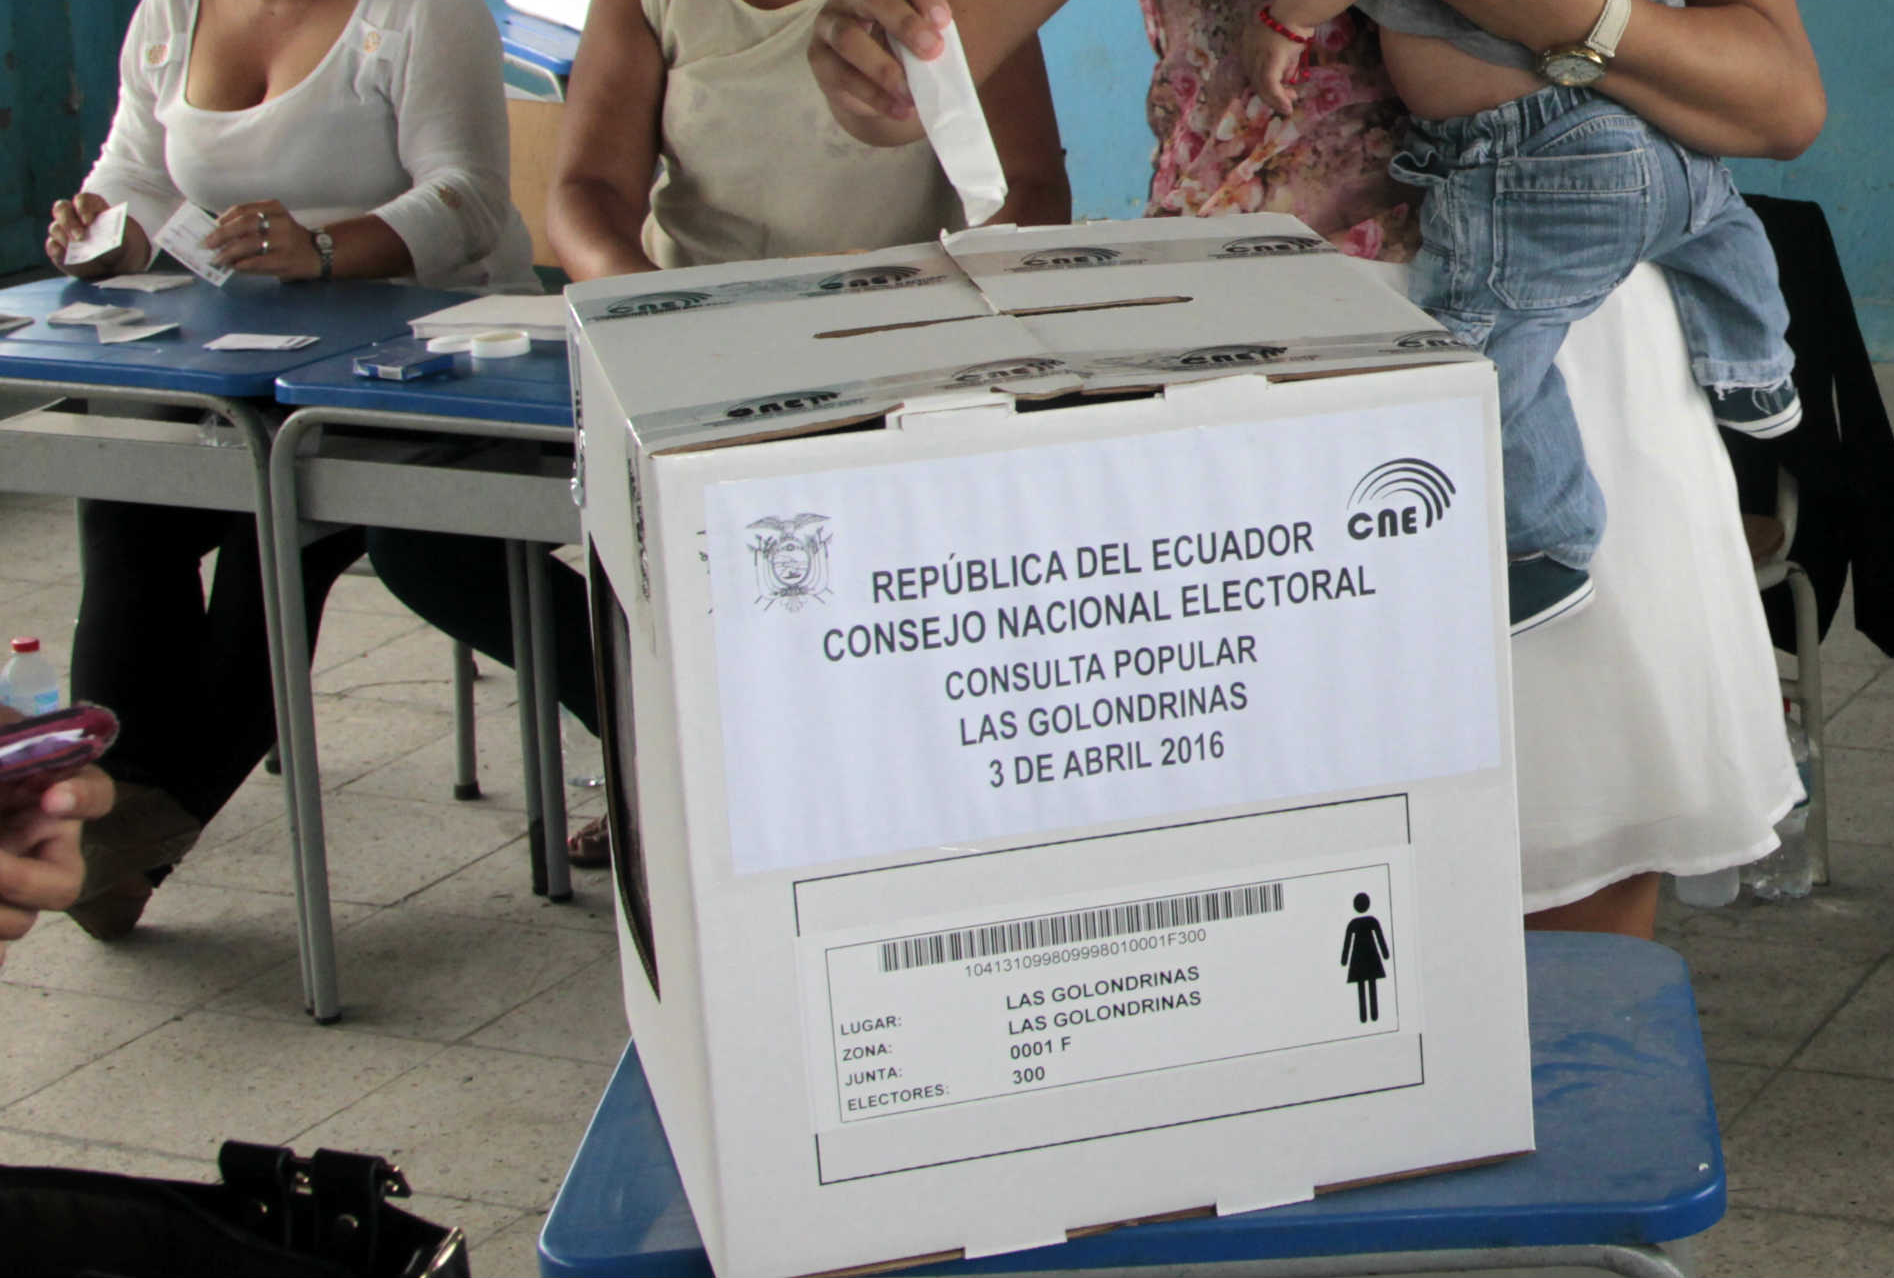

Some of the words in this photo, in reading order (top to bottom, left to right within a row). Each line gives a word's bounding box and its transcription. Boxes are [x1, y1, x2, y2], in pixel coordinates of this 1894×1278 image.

[1347, 505, 1417, 540] CNE
[871, 550, 1067, 603] REPÚBLICA
[1077, 543, 1142, 580] DEL
[1152, 521, 1314, 571] ECUADOR
[823, 610, 986, 662] CONSEJO
[997, 590, 1172, 640] NACIONAL
[1181, 565, 1376, 618] ELECTORAL
[945, 653, 1106, 701] CONSULTA
[1114, 634, 1257, 679] POPULAR
[960, 710, 1018, 746] LAS
[1027, 681, 1249, 737] GOLONDRINAS
[989, 759, 1005, 788] 3
[1014, 753, 1055, 785] DE
[1063, 740, 1152, 779] ABRIL
[1160, 730, 1225, 766] 2016
[1006, 990, 1046, 1011] LAS
[1051, 965, 1200, 1003] GOLONDRINAS
[840, 1015, 902, 1036] LUGAR:
[1008, 1015, 1048, 1035] LAS
[1053, 990, 1202, 1028] GOLONDRINAS
[842, 1043, 893, 1062] ZONA:
[1009, 1039, 1054, 1060] 0001
[1060, 1036, 1073, 1052] F
[844, 1067, 903, 1087] JUNTA:
[1012, 1065, 1046, 1085] 300
[847, 1083, 951, 1112] ELECTORES:
